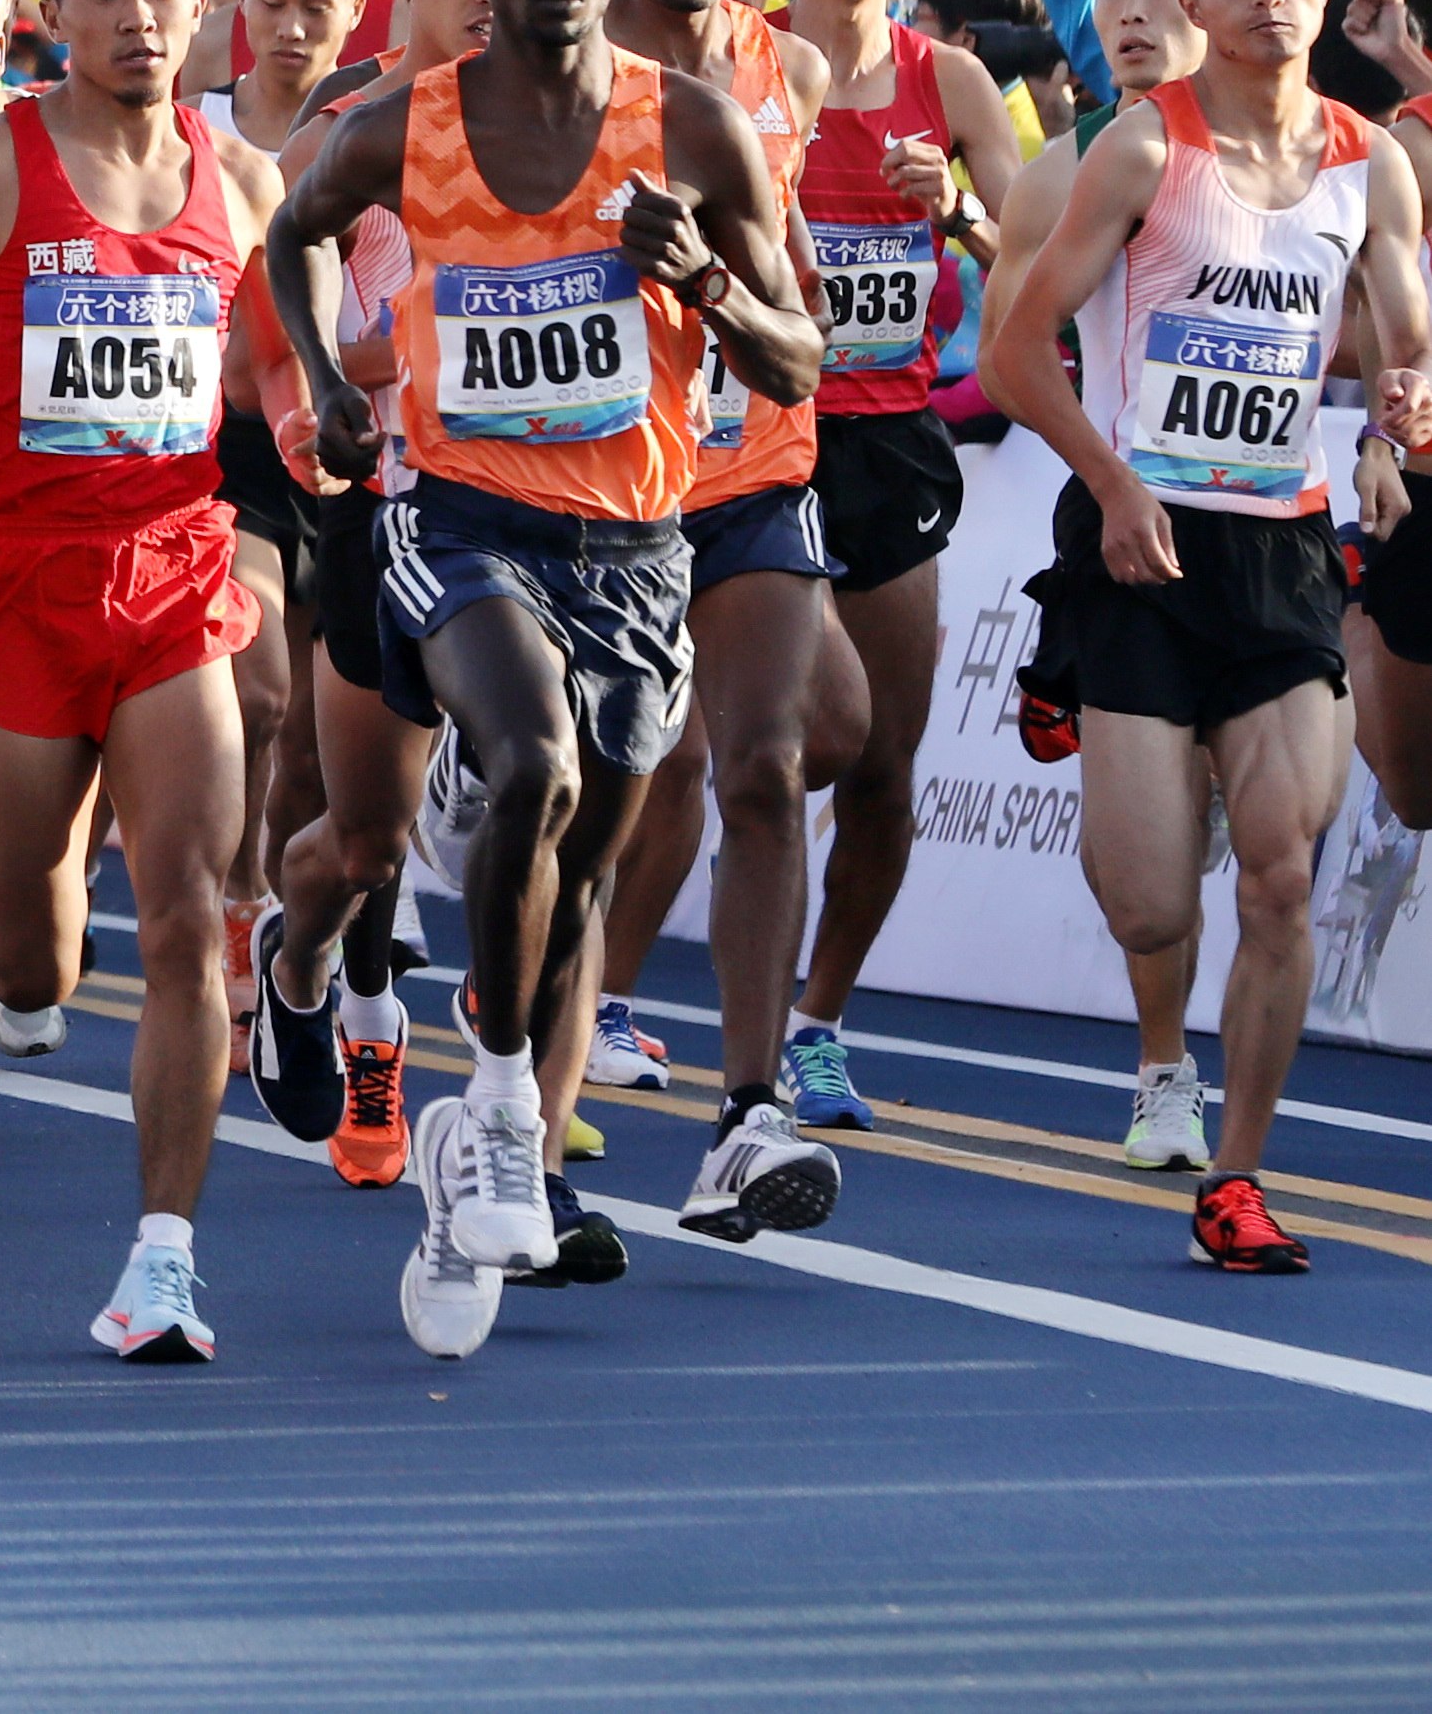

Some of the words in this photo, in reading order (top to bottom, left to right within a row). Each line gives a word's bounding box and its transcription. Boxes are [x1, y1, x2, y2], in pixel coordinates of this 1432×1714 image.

[25, 237, 97, 276] 西藏
[64, 292, 188, 324] 六个核桃
[467, 271, 600, 314] 六个核桃
[1186, 264, 1321, 316] YUNNAN
[49, 336, 197, 400] A054
[461, 313, 622, 391] A008
[1183, 336, 1302, 377] 六个核桃
[1160, 374, 1300, 447] A062
[914, 775, 997, 847] CHINA
